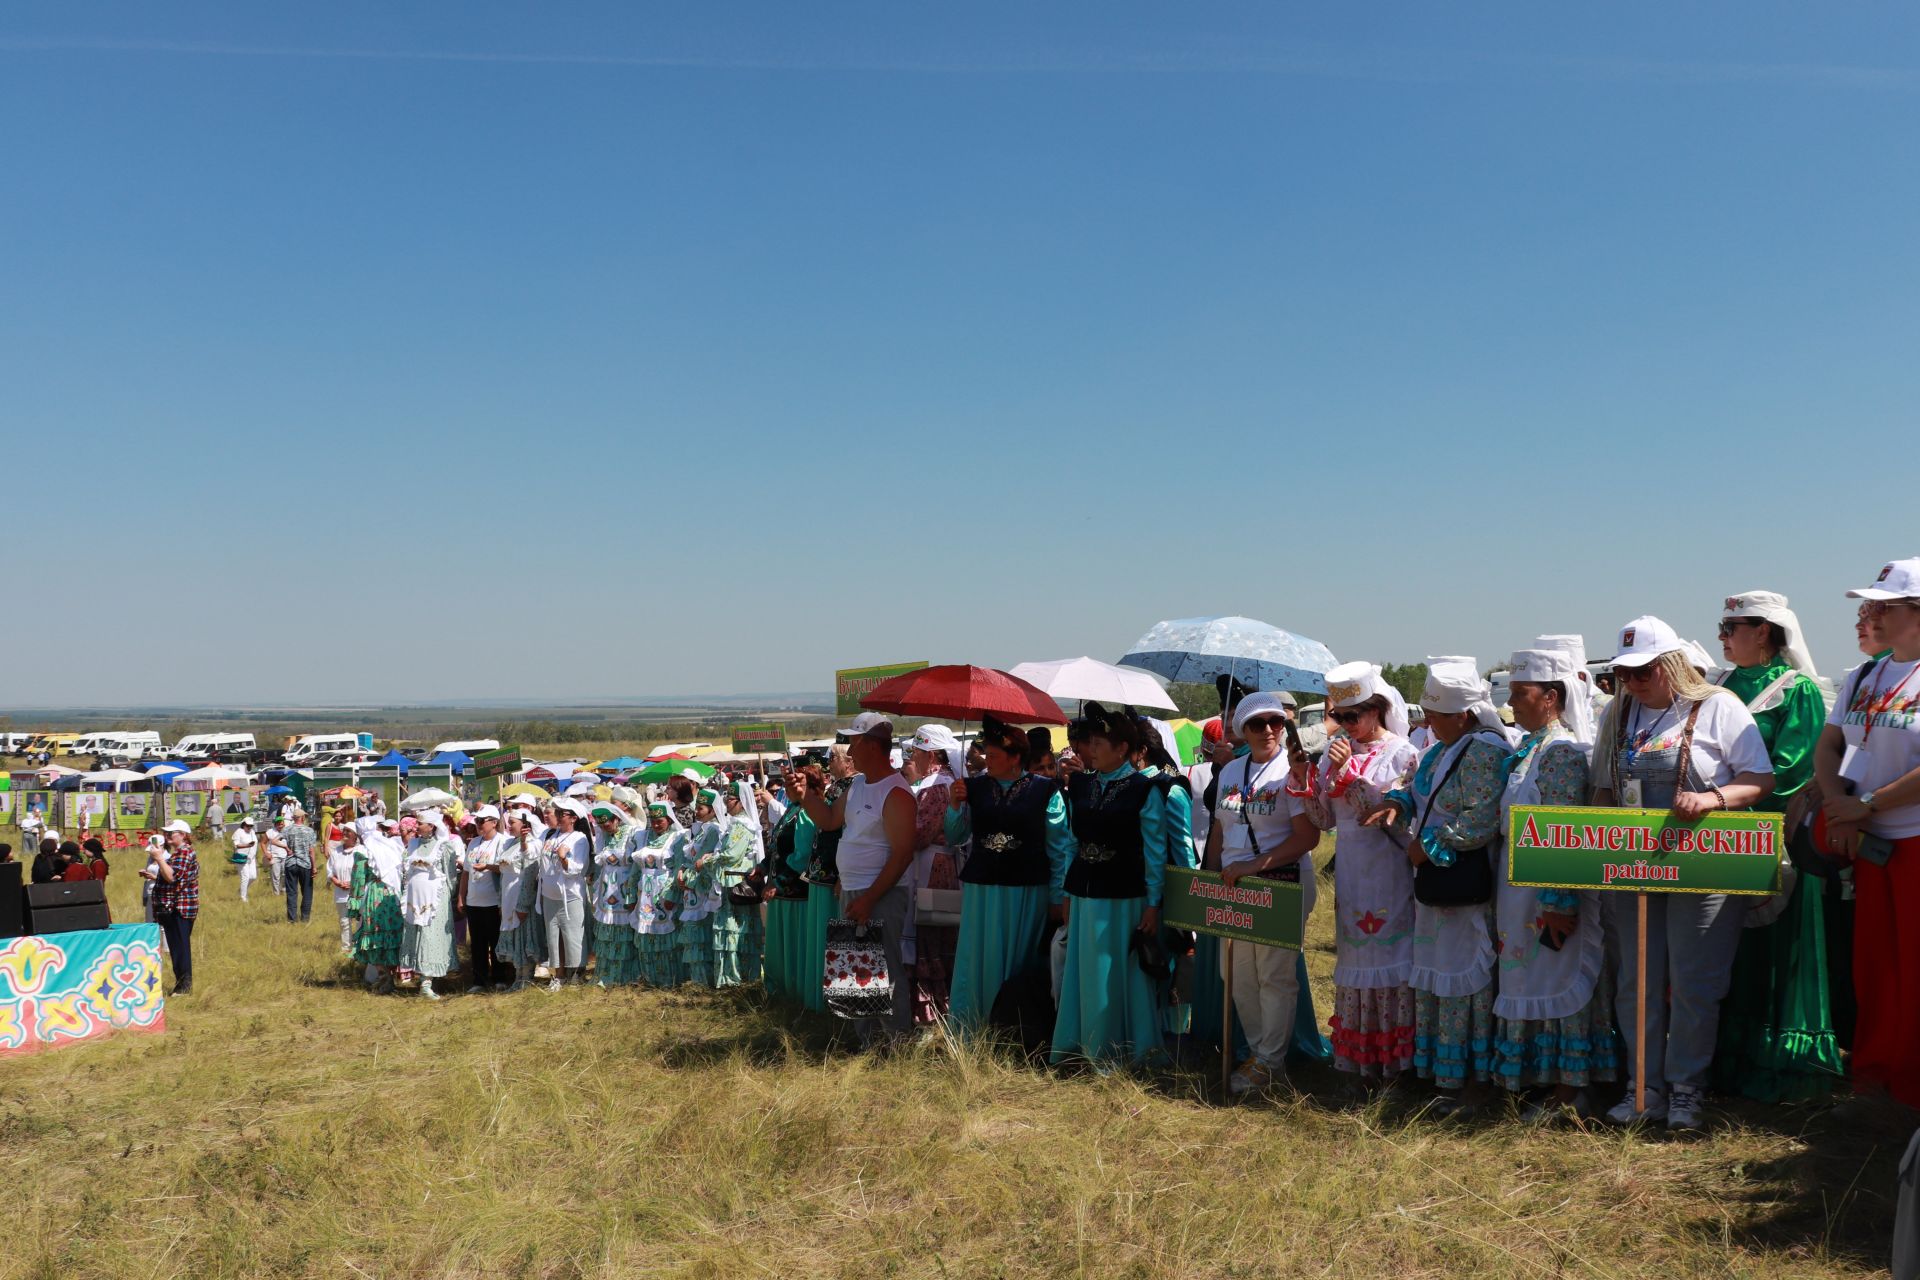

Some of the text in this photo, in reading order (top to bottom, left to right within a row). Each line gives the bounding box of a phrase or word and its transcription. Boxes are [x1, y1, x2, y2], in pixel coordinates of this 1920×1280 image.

[1517, 812, 1775, 855] Альметьевский
[1602, 860, 1679, 883] район
[1189, 877, 1272, 908] Атнинский
[1206, 905, 1253, 930] район
